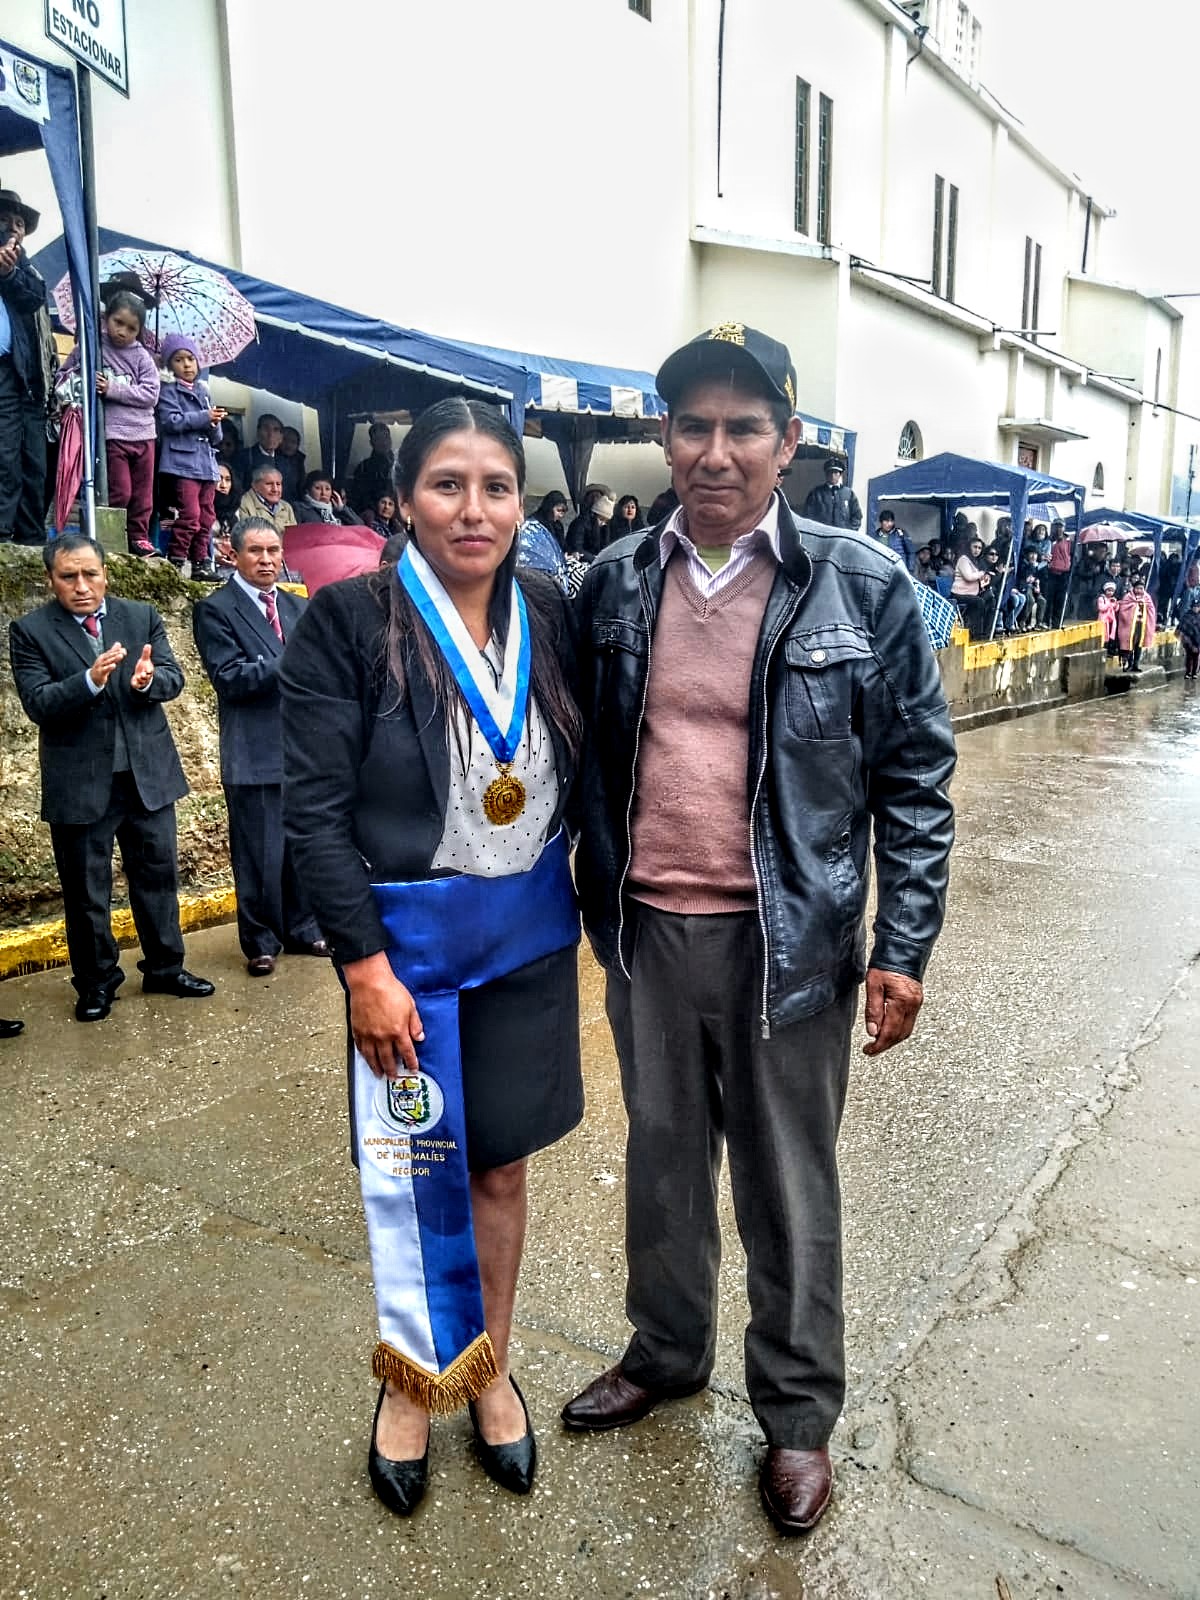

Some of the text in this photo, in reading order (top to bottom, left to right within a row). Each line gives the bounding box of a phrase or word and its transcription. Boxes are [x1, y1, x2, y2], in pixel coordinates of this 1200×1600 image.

[73, 0, 100, 28] NO
[52, 8, 122, 79] ESTACIONAR
[416, 1139, 457, 1149] PROVINCIAL
[376, 1150, 445, 1161] DE HUAMALÍES
